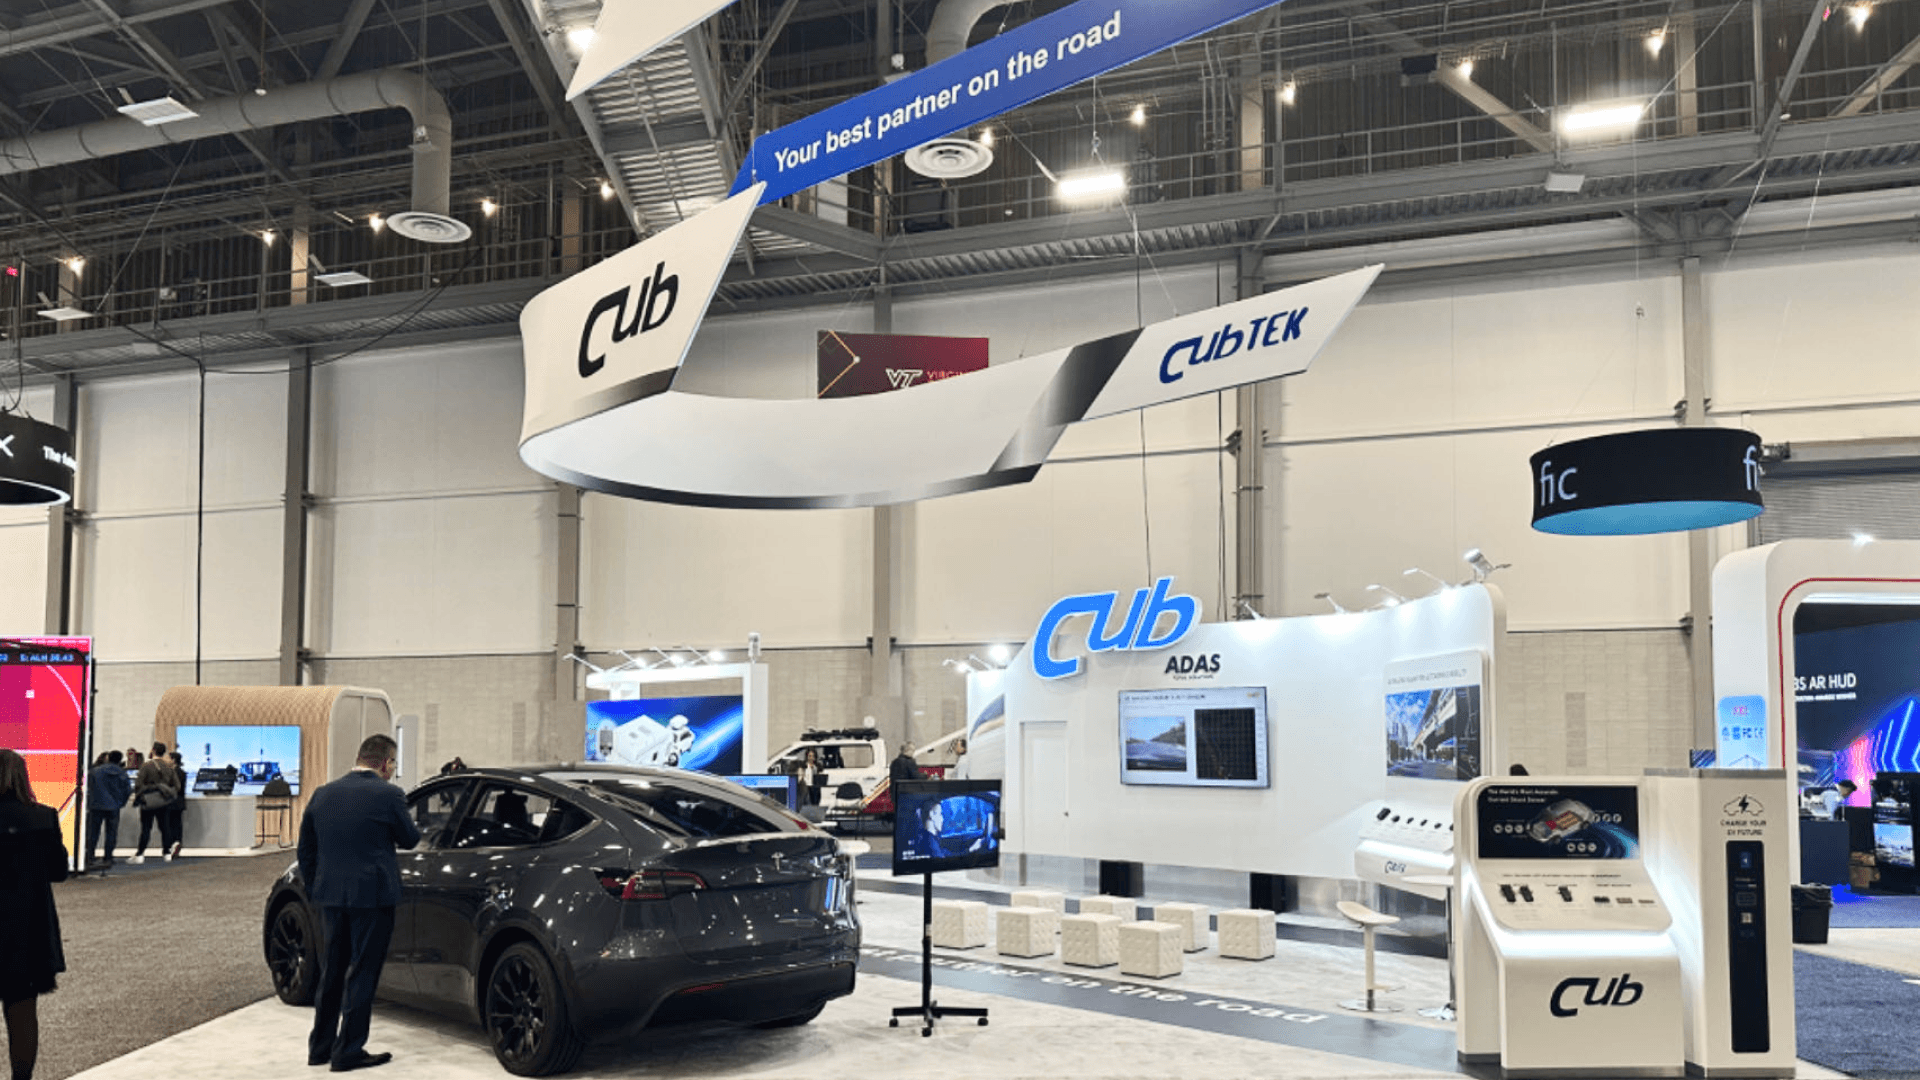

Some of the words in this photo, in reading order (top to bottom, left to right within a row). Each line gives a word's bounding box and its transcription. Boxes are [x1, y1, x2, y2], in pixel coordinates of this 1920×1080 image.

[774, 140, 821, 172] Your
[826, 116, 871, 153] best
[877, 83, 962, 140] partner
[968, 69, 999, 96] on
[1007, 48, 1049, 80] the
[1057, 10, 1121, 60] road
[886, 368, 923, 388] VT
[1540, 461, 1578, 506] fic
[1032, 577, 1200, 679] Cub
[1165, 653, 1221, 674] ADAS
[1809, 675, 1826, 690] AR
[1828, 672, 1857, 689] HUD
[1041, 976, 1102, 989] on
[1108, 984, 1188, 1002] the
[1193, 999, 1329, 1024] road
[1550, 973, 1644, 1018] Cub
